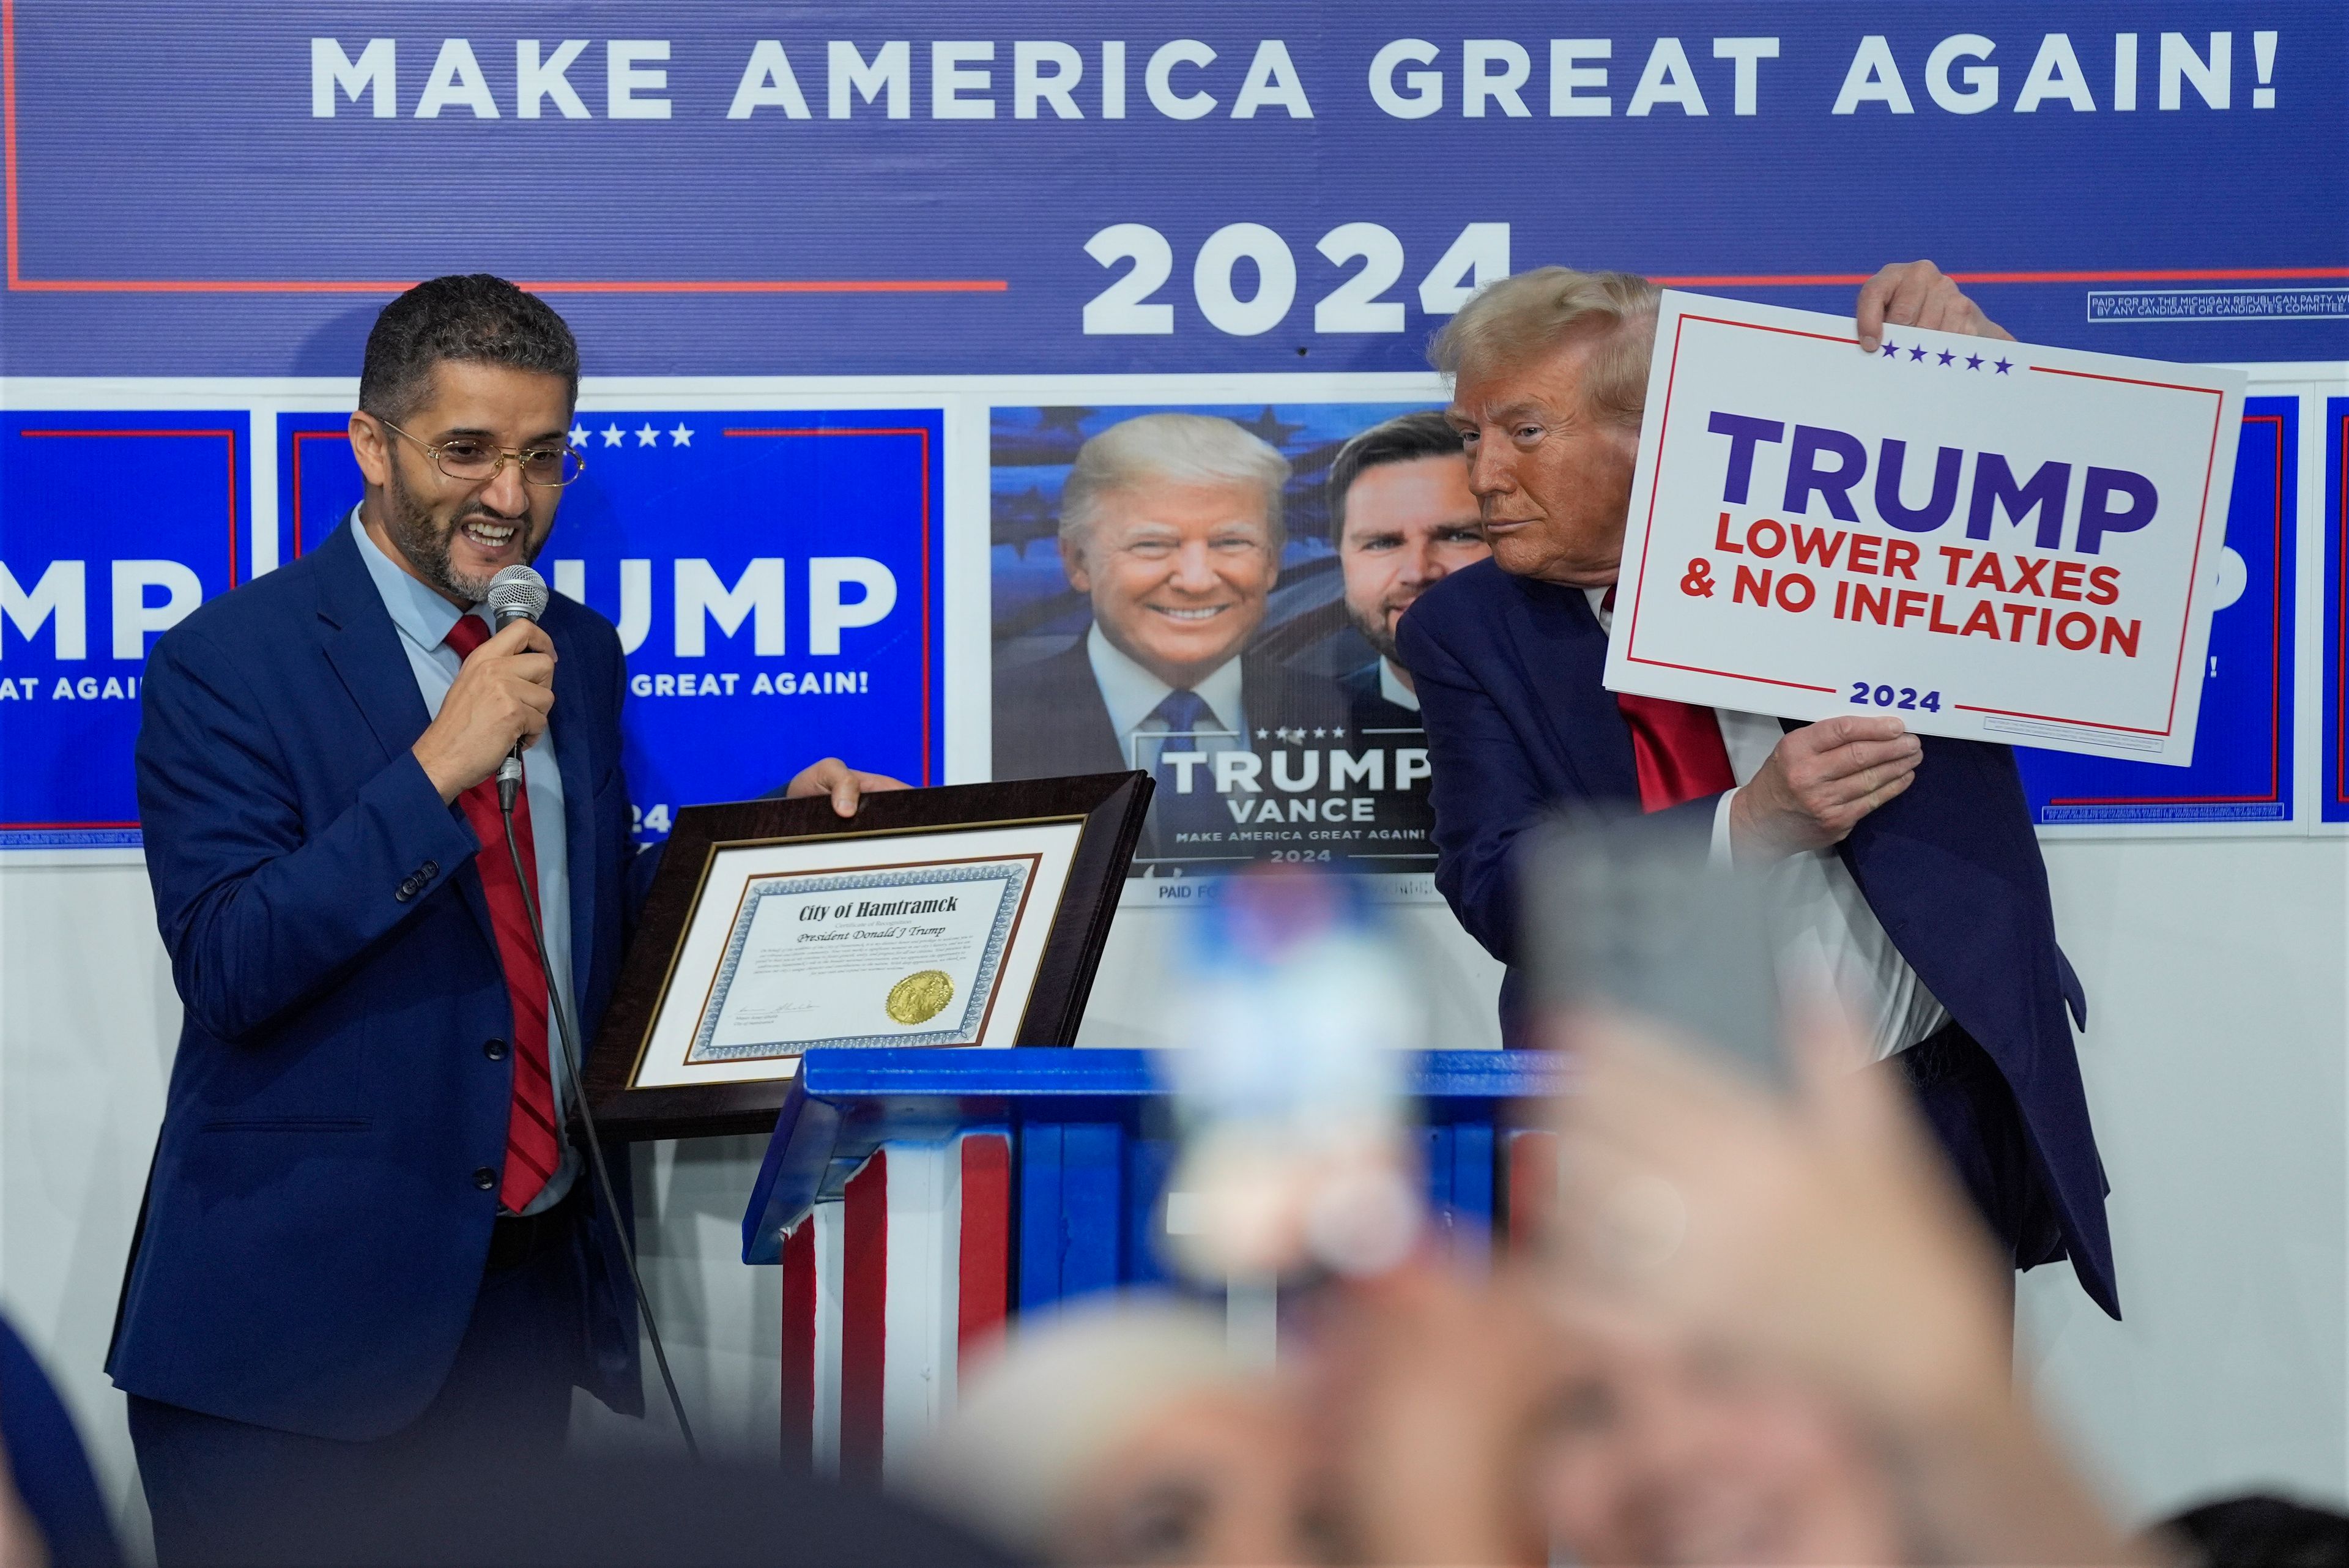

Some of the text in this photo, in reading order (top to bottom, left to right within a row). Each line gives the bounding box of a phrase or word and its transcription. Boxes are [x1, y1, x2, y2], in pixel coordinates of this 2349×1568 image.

[311, 31, 2278, 120] MAKE AMERICA GREAT AGAIN!
[1083, 221, 1511, 336] 2024
[2092, 297, 2115, 307] PAID
[2118, 297, 2139, 306] FOR
[2142, 297, 2155, 305] BY
[2158, 296, 2177, 305] THE
[2181, 295, 2230, 305] MICHIGAN
[2233, 295, 2297, 305] REPUBLICAN
[2098, 307, 2110, 316] BY
[2113, 306, 2135, 316] ANY
[2137, 305, 2196, 315] CANDIDATE
[2199, 305, 2213, 314] OR
[2216, 303, 2282, 314] CANDIDATE'S
[1707, 411, 2159, 555] TRUMP
[1715, 513, 2120, 604] LOWER TAXES
[1680, 557, 2142, 658] & NO INFLATION
[53, 677, 142, 700] AGAI
[631, 671, 869, 697] GREAT AGAIN!
[1850, 682, 1941, 713] 2024
[1162, 748, 1432, 794] TRUMP
[1226, 797, 1375, 823] VANCE
[1176, 829, 1425, 843] MAKE AMERICA GREAT AGAIN!
[1270, 849, 1332, 863] 2024
[1159, 885, 1192, 898] PAID
[799, 896, 959, 921] City of Hamtramck
[797, 926, 946, 943] President Donald J Trump
